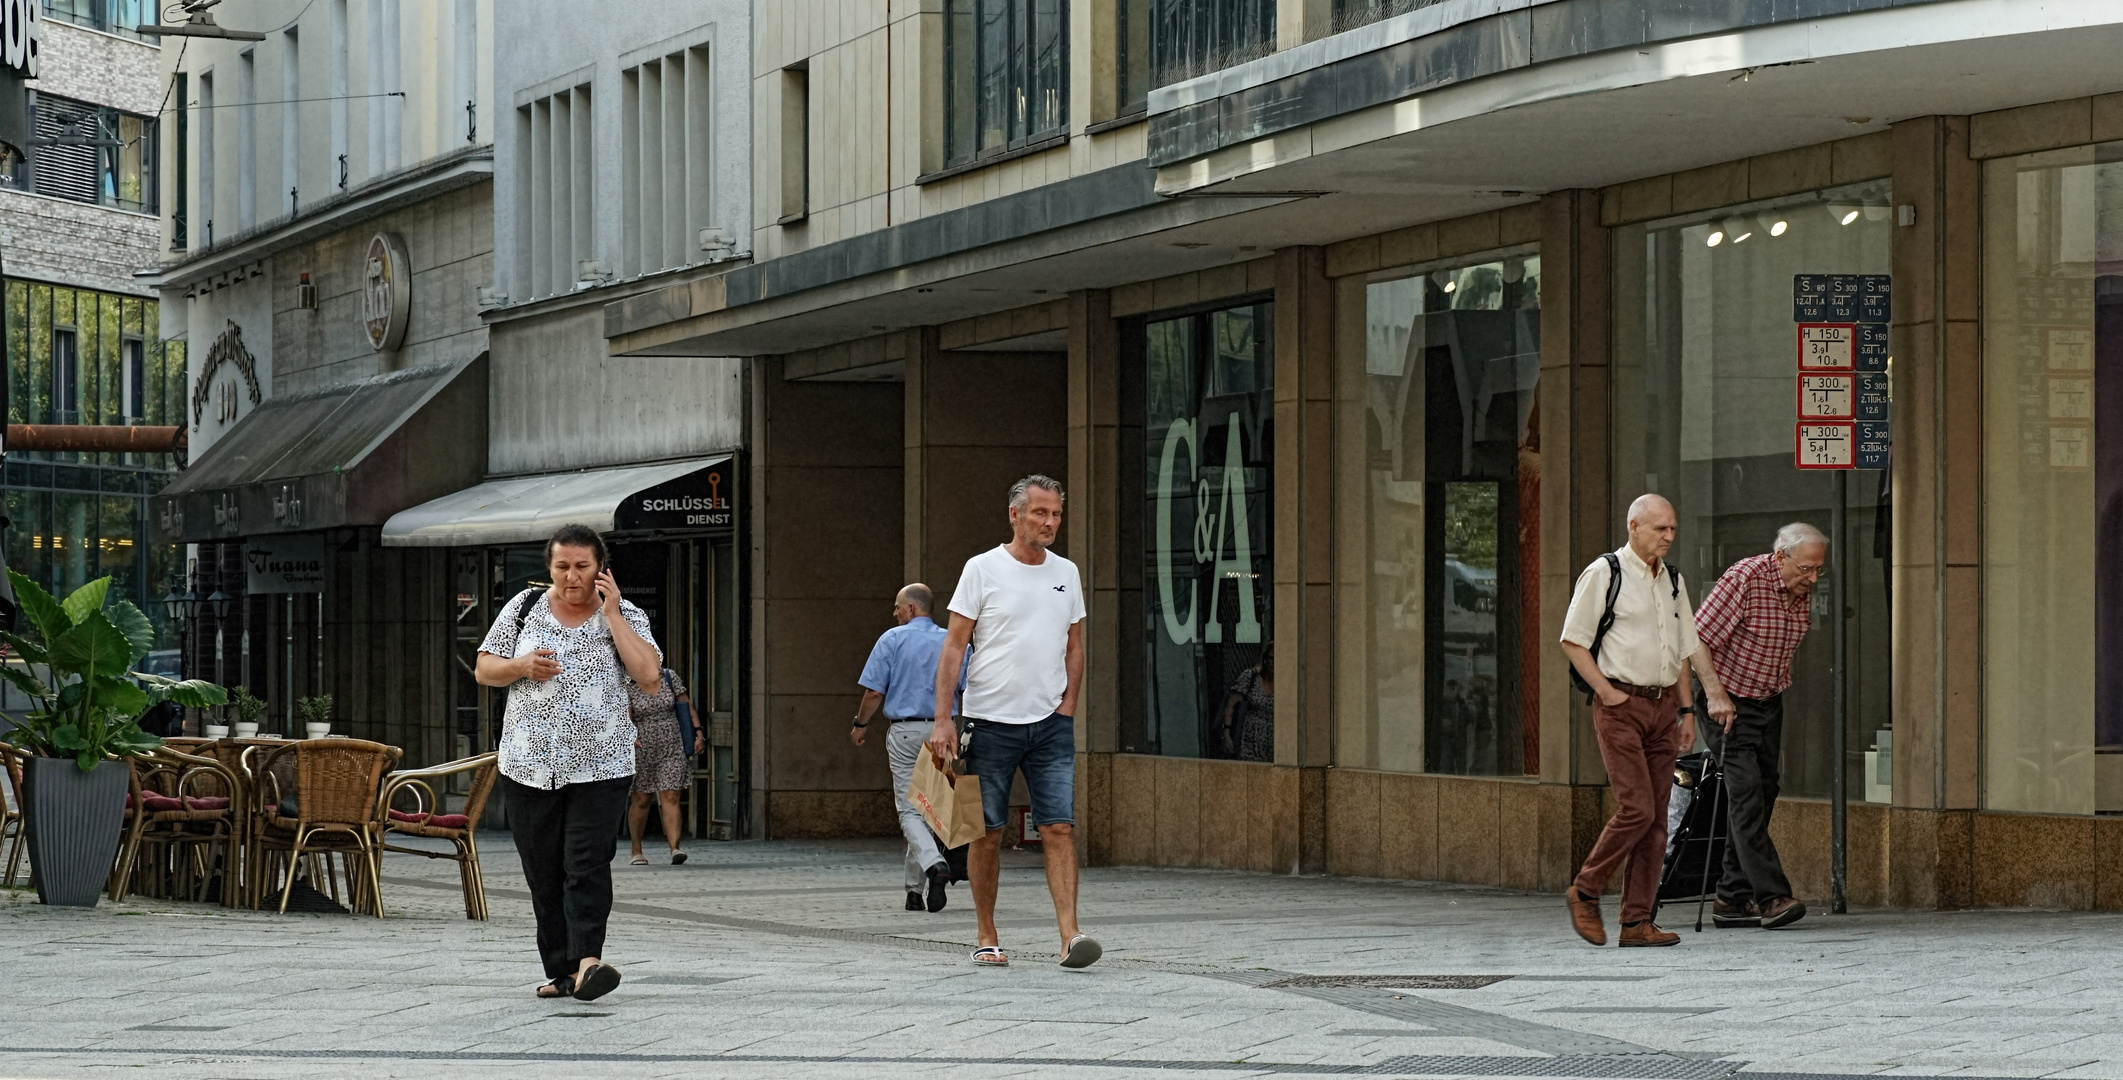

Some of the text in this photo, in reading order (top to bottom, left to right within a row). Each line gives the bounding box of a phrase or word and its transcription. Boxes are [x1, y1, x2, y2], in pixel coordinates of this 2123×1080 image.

[1802, 281, 1810, 291] S
[1834, 281, 1842, 292] S
[1867, 281, 1874, 292] S
[1802, 329, 1839, 339] H 150
[1864, 330, 1872, 341] S
[1802, 378, 1810, 388] H
[1818, 378, 1839, 388] 300
[1864, 379, 1887, 390] S 300
[1801, 427, 1809, 437] H
[1817, 427, 1839, 437] 300
[1864, 428, 1888, 439] S 300
[642, 496, 730, 512] SCHLÜSSEL
[686, 514, 730, 525] DIENST
[1156, 411, 1261, 646] C&A
